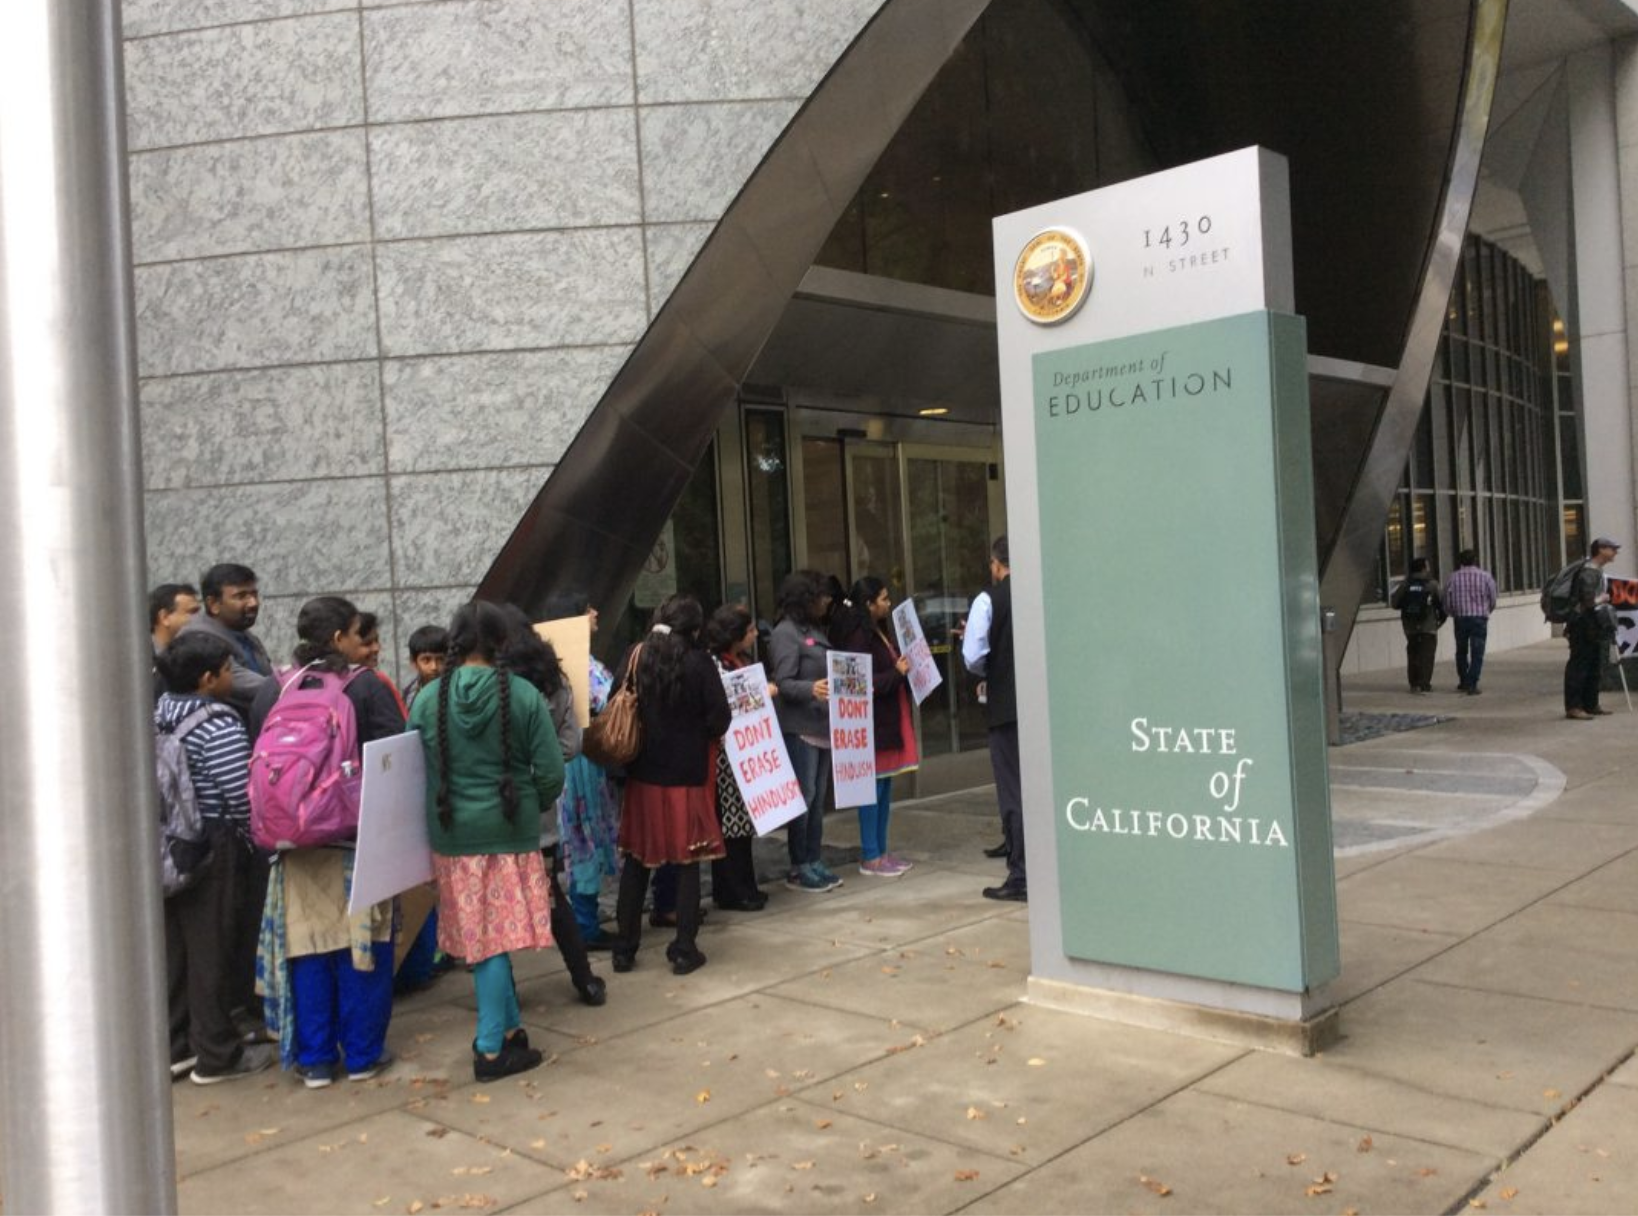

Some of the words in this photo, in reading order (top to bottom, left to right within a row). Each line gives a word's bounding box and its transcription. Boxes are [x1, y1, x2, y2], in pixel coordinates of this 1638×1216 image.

[1144, 215, 1212, 249] 1430
[1143, 265, 1154, 277] N
[1169, 247, 1230, 273] STREET
[1053, 359, 1145, 388] Department
[1150, 351, 1170, 374] of
[1049, 367, 1232, 417] EDUCATION
[838, 698, 869, 720] DONT
[733, 717, 773, 751] DONT
[833, 728, 868, 749] ERASE
[739, 750, 781, 783] ERASE
[835, 762, 873, 781] HINDUISM
[1209, 758, 1254, 812] of
